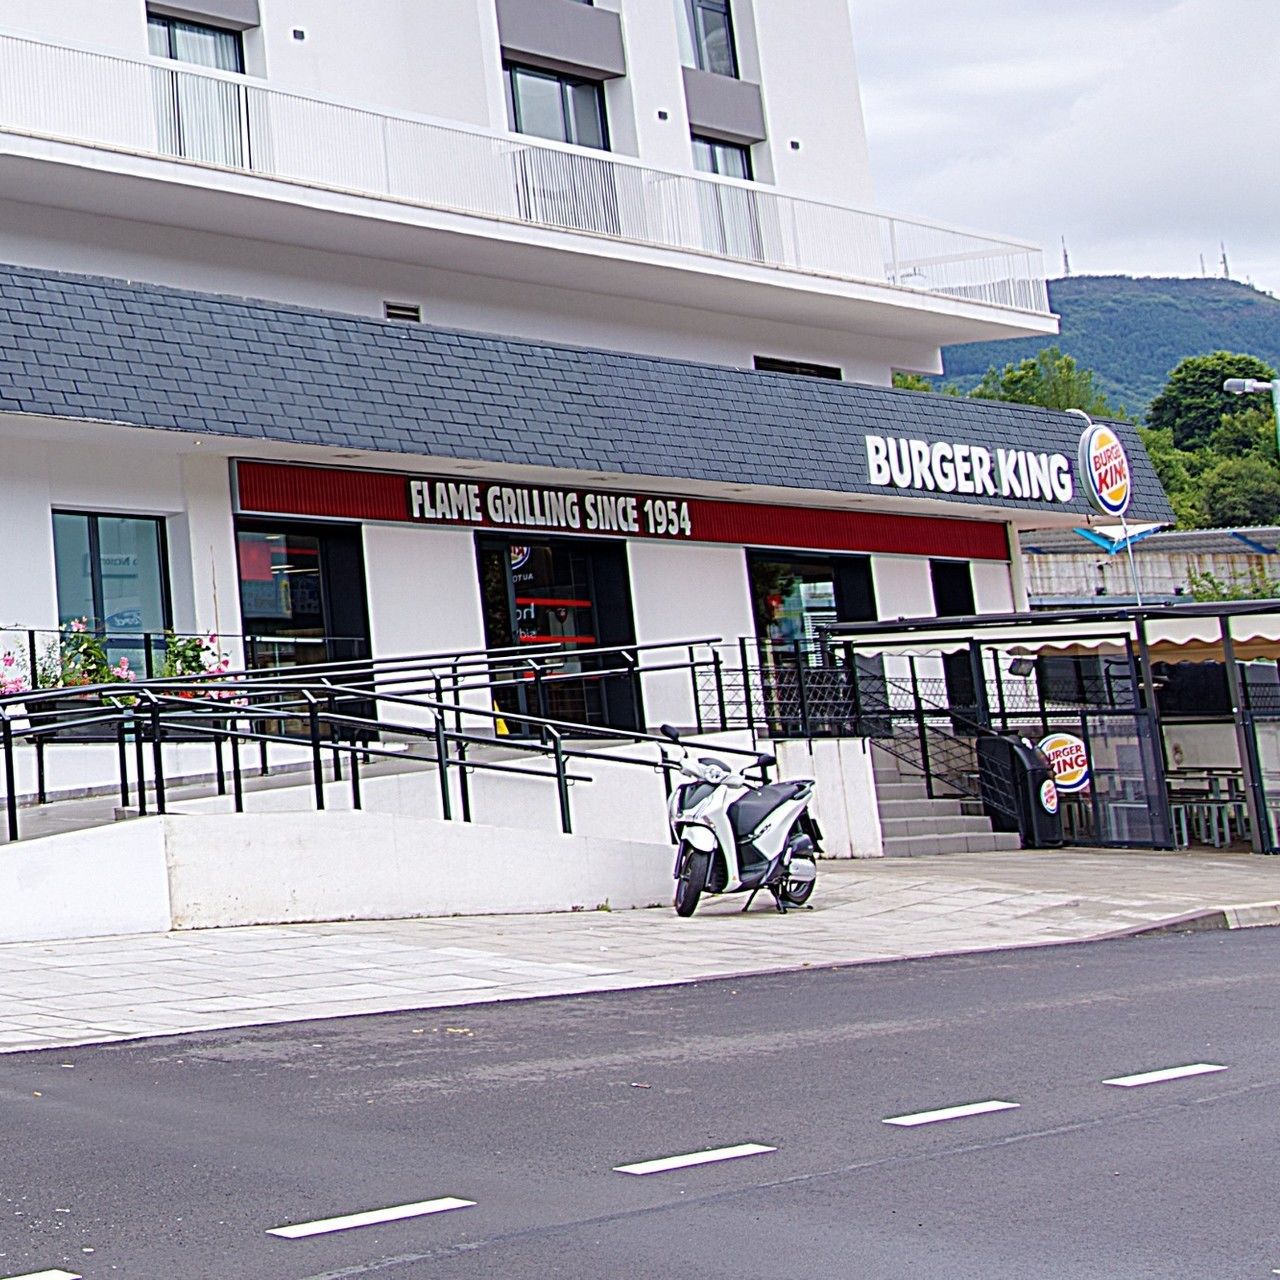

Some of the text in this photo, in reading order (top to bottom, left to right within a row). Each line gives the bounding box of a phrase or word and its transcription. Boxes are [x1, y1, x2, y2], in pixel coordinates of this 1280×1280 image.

[864, 435, 1074, 503] BURGER KING
[1093, 443, 1124, 472] BURGE
[410, 481, 691, 536] FLAME GRILLING SINCE 1954
[1048, 744, 1083, 763] URGER
[1051, 754, 1088, 775] ING
